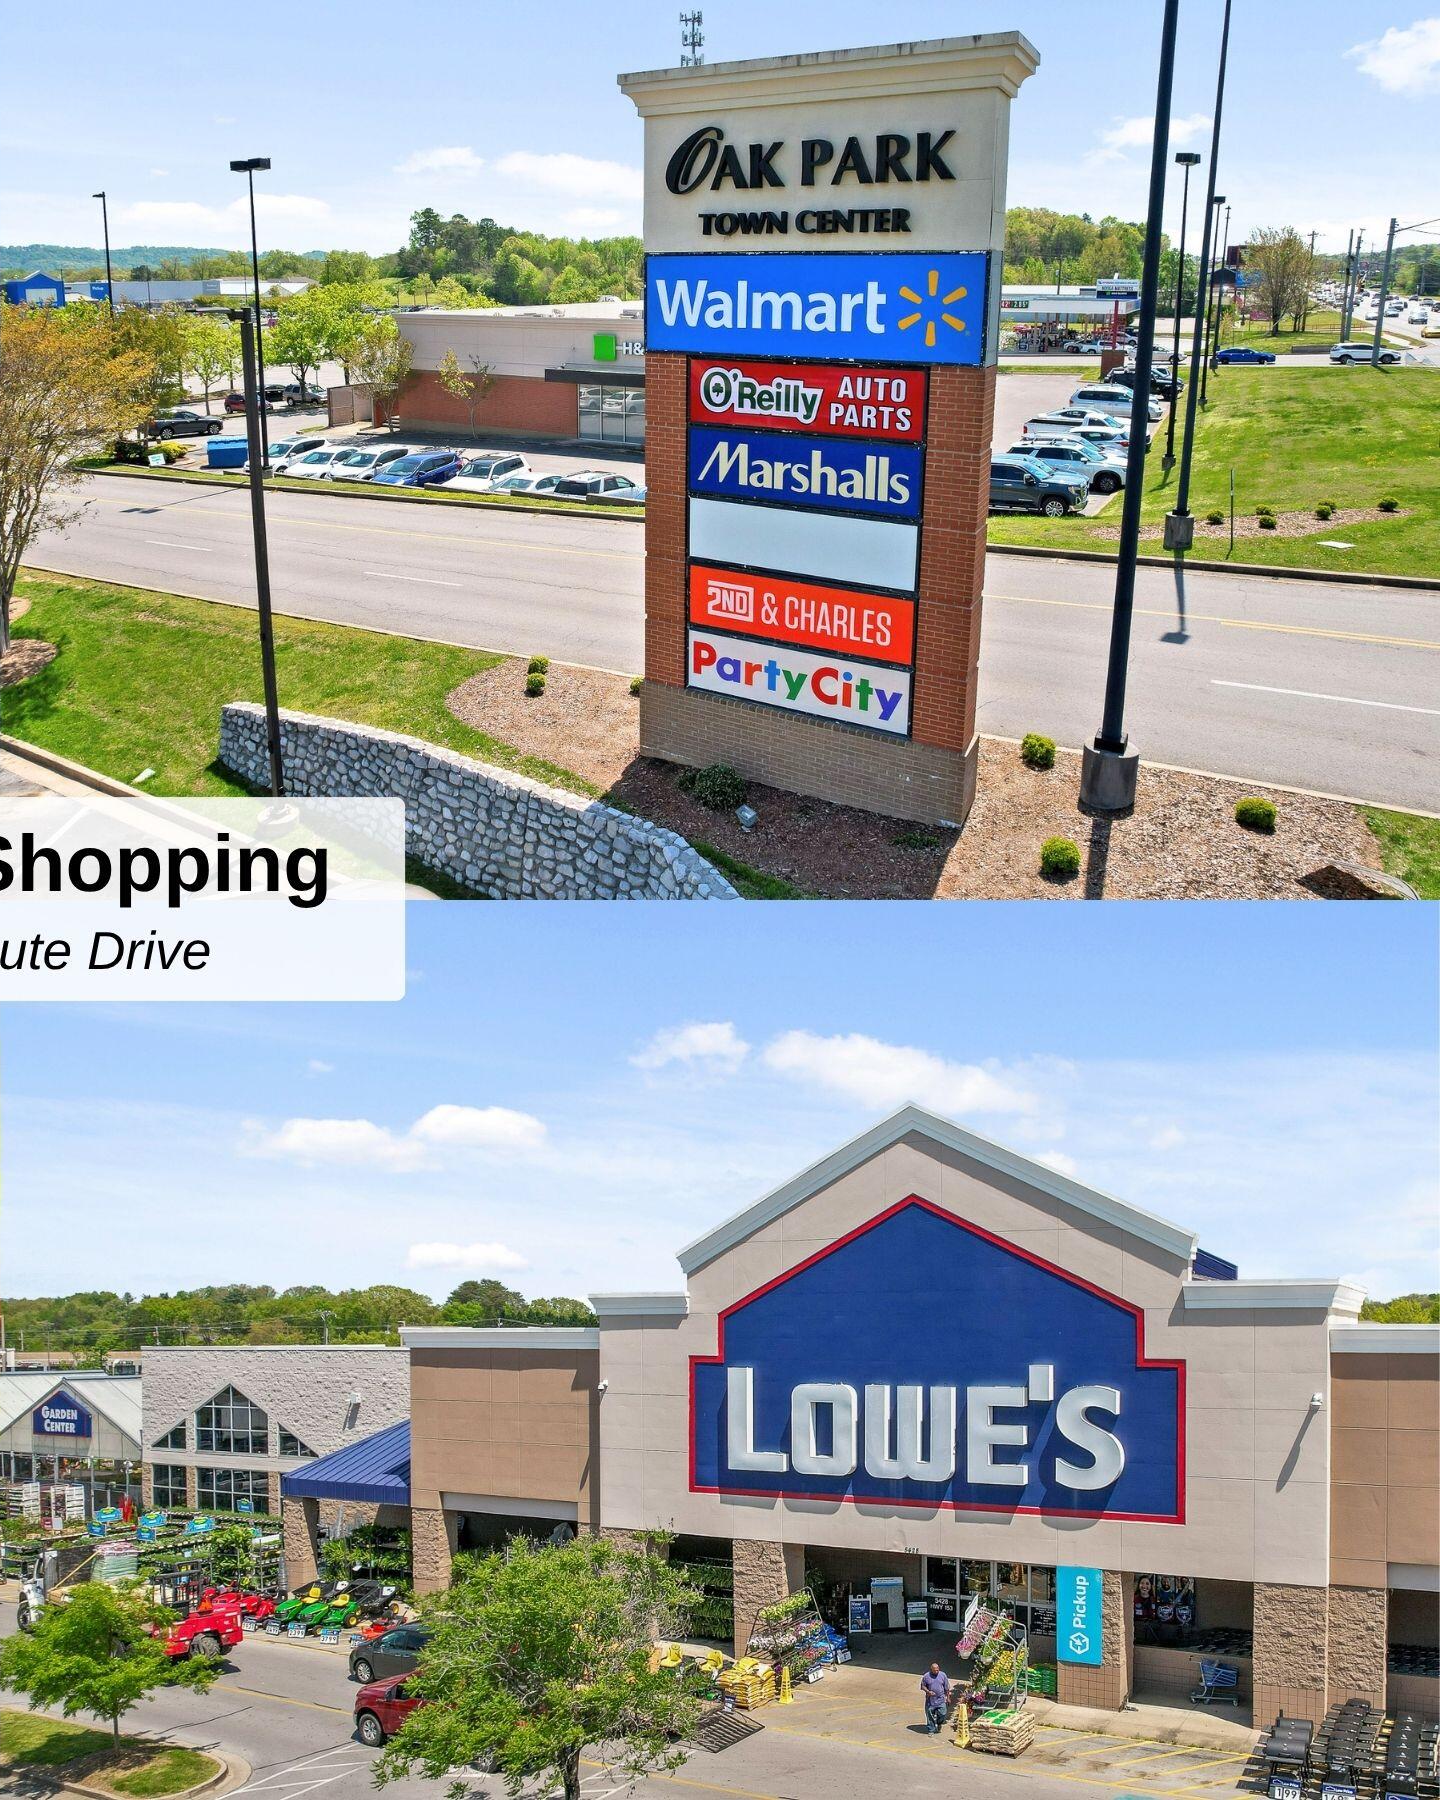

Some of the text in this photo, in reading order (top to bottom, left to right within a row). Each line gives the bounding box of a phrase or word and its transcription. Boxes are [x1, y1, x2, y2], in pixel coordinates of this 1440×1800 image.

[665, 126, 957, 195] OAK PARK
[698, 208, 912, 236] TOWN CENTER
[655, 278, 887, 336] Walmart
[701, 367, 822, 424] O'Reilly
[837, 377, 907, 402] AUTO
[830, 403, 912, 432] PARTS
[697, 441, 910, 505] Marshalls
[707, 580, 892, 647] 2ND & CHARLES
[41, 1406, 78, 1420] GARDEN
[44, 1419, 76, 1433] CENTER
[727, 1364, 1125, 1490] LOWE'S
[1072, 1575, 1090, 1629] Pickup
[1277, 1787, 1297, 1799] 199
